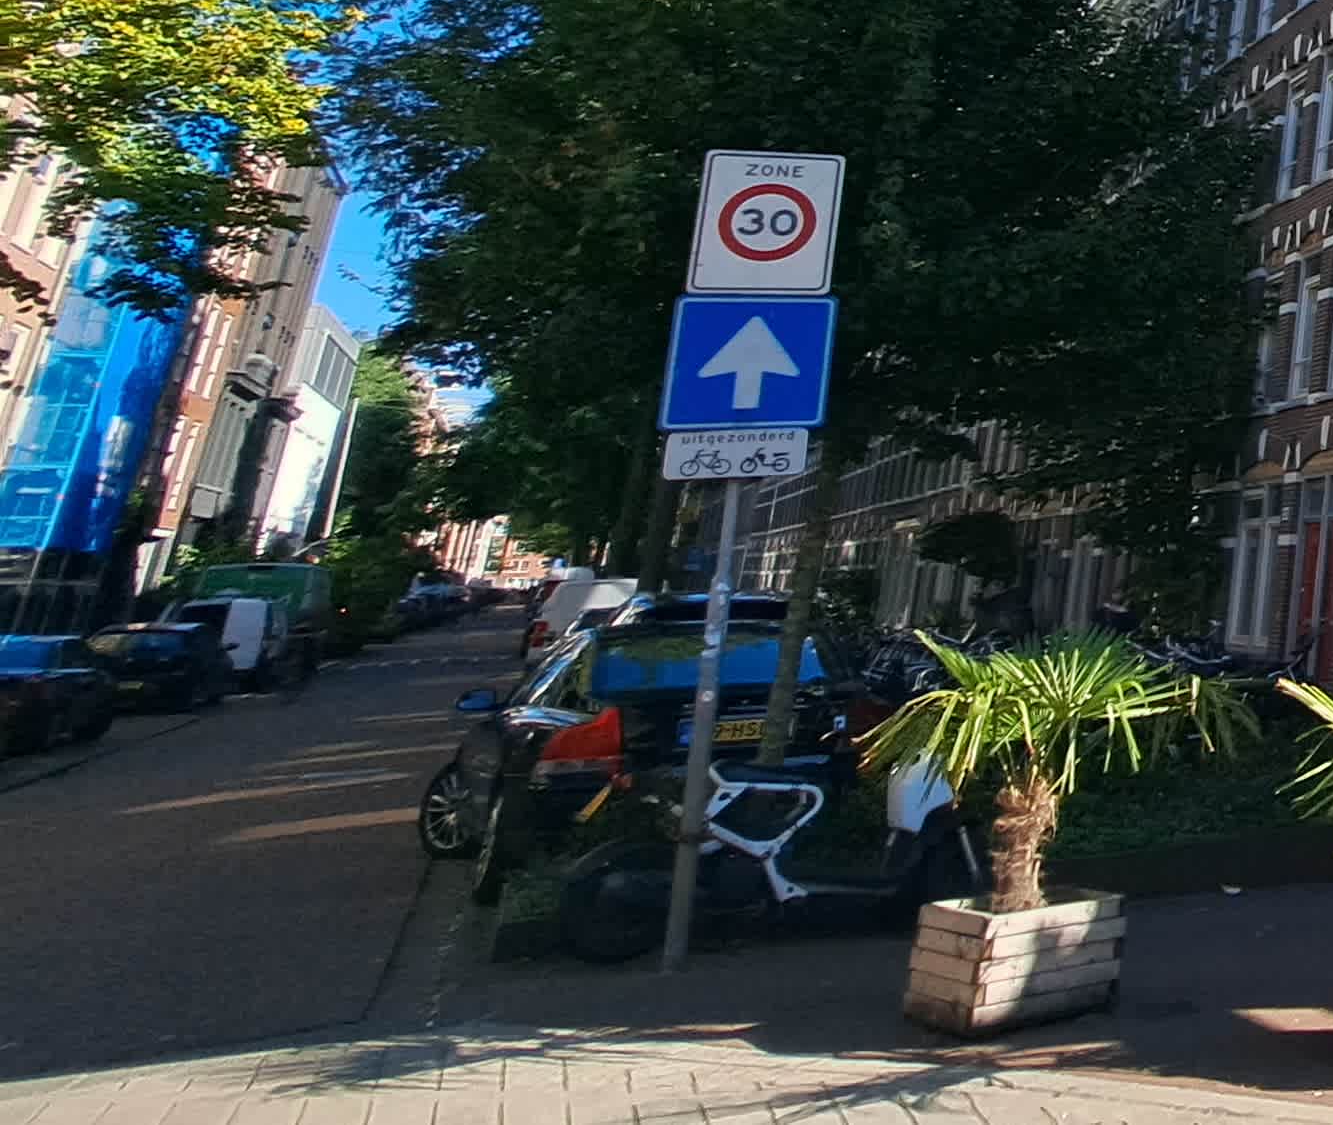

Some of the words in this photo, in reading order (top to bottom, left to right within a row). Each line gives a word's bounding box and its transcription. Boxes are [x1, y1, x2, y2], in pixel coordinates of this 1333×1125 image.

[746, 163, 804, 178] ZONE
[738, 209, 797, 236] 30
[681, 431, 795, 446] uitgezonderd
